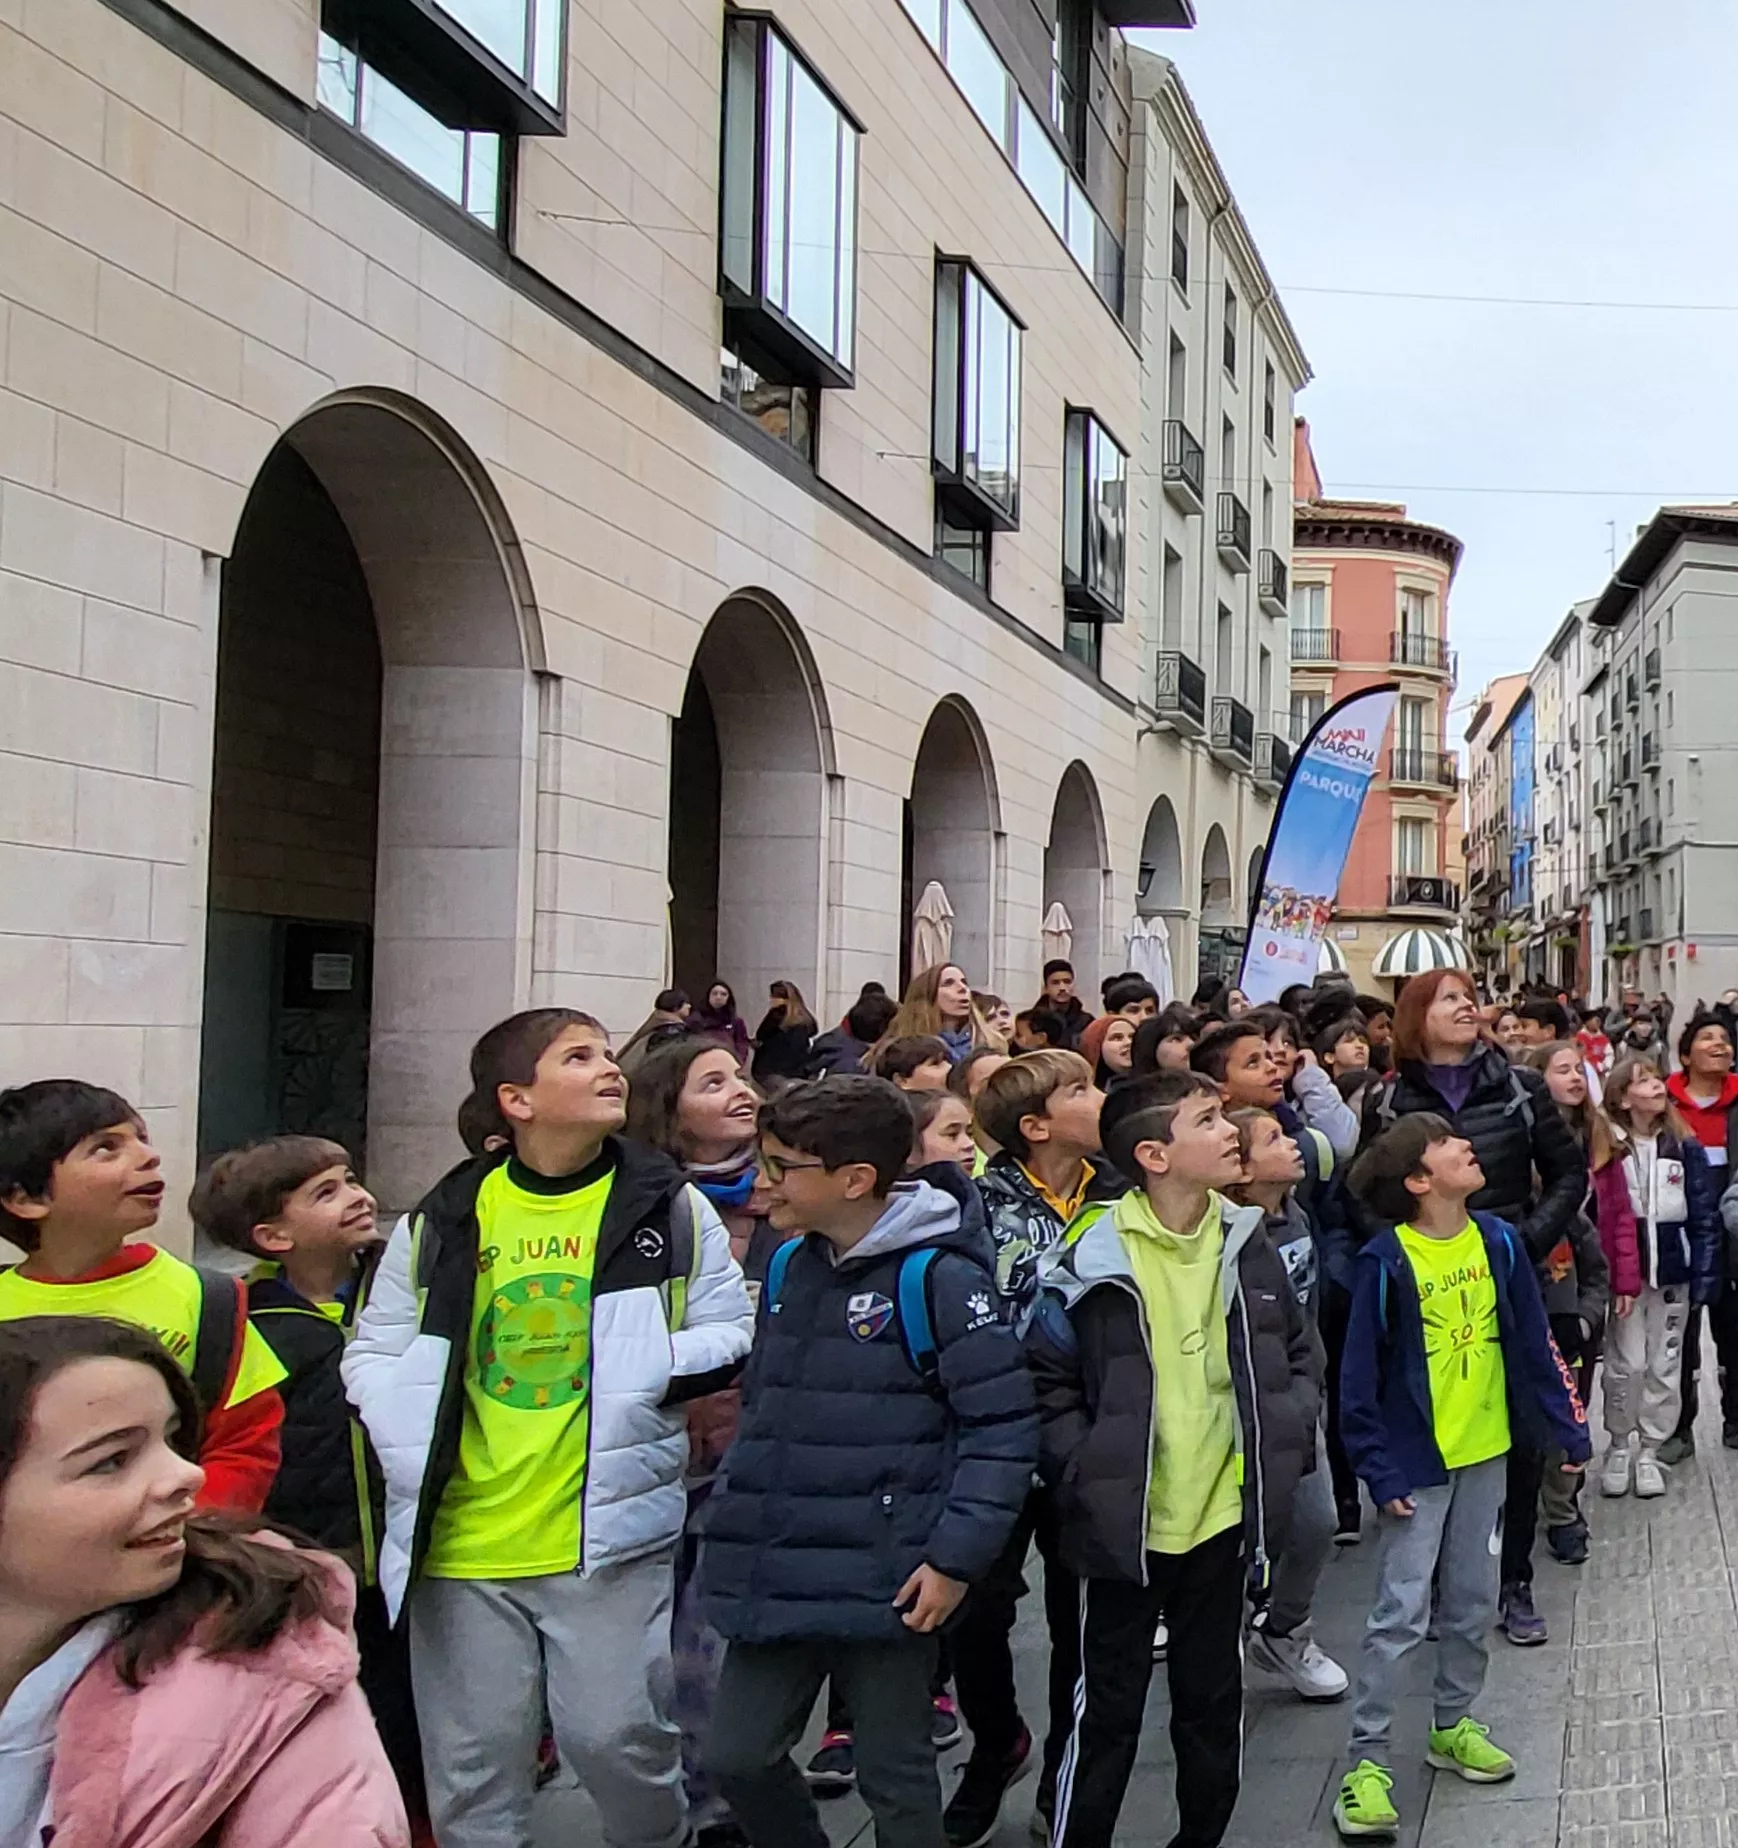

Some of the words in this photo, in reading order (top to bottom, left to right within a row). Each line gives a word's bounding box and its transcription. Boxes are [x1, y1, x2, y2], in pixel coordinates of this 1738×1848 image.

[1313, 735, 1376, 764] MARCHA
[510, 1235, 581, 1264] JUAN
[1441, 1267, 1478, 1293] JUAN
[1450, 1323, 1474, 1347] 50
